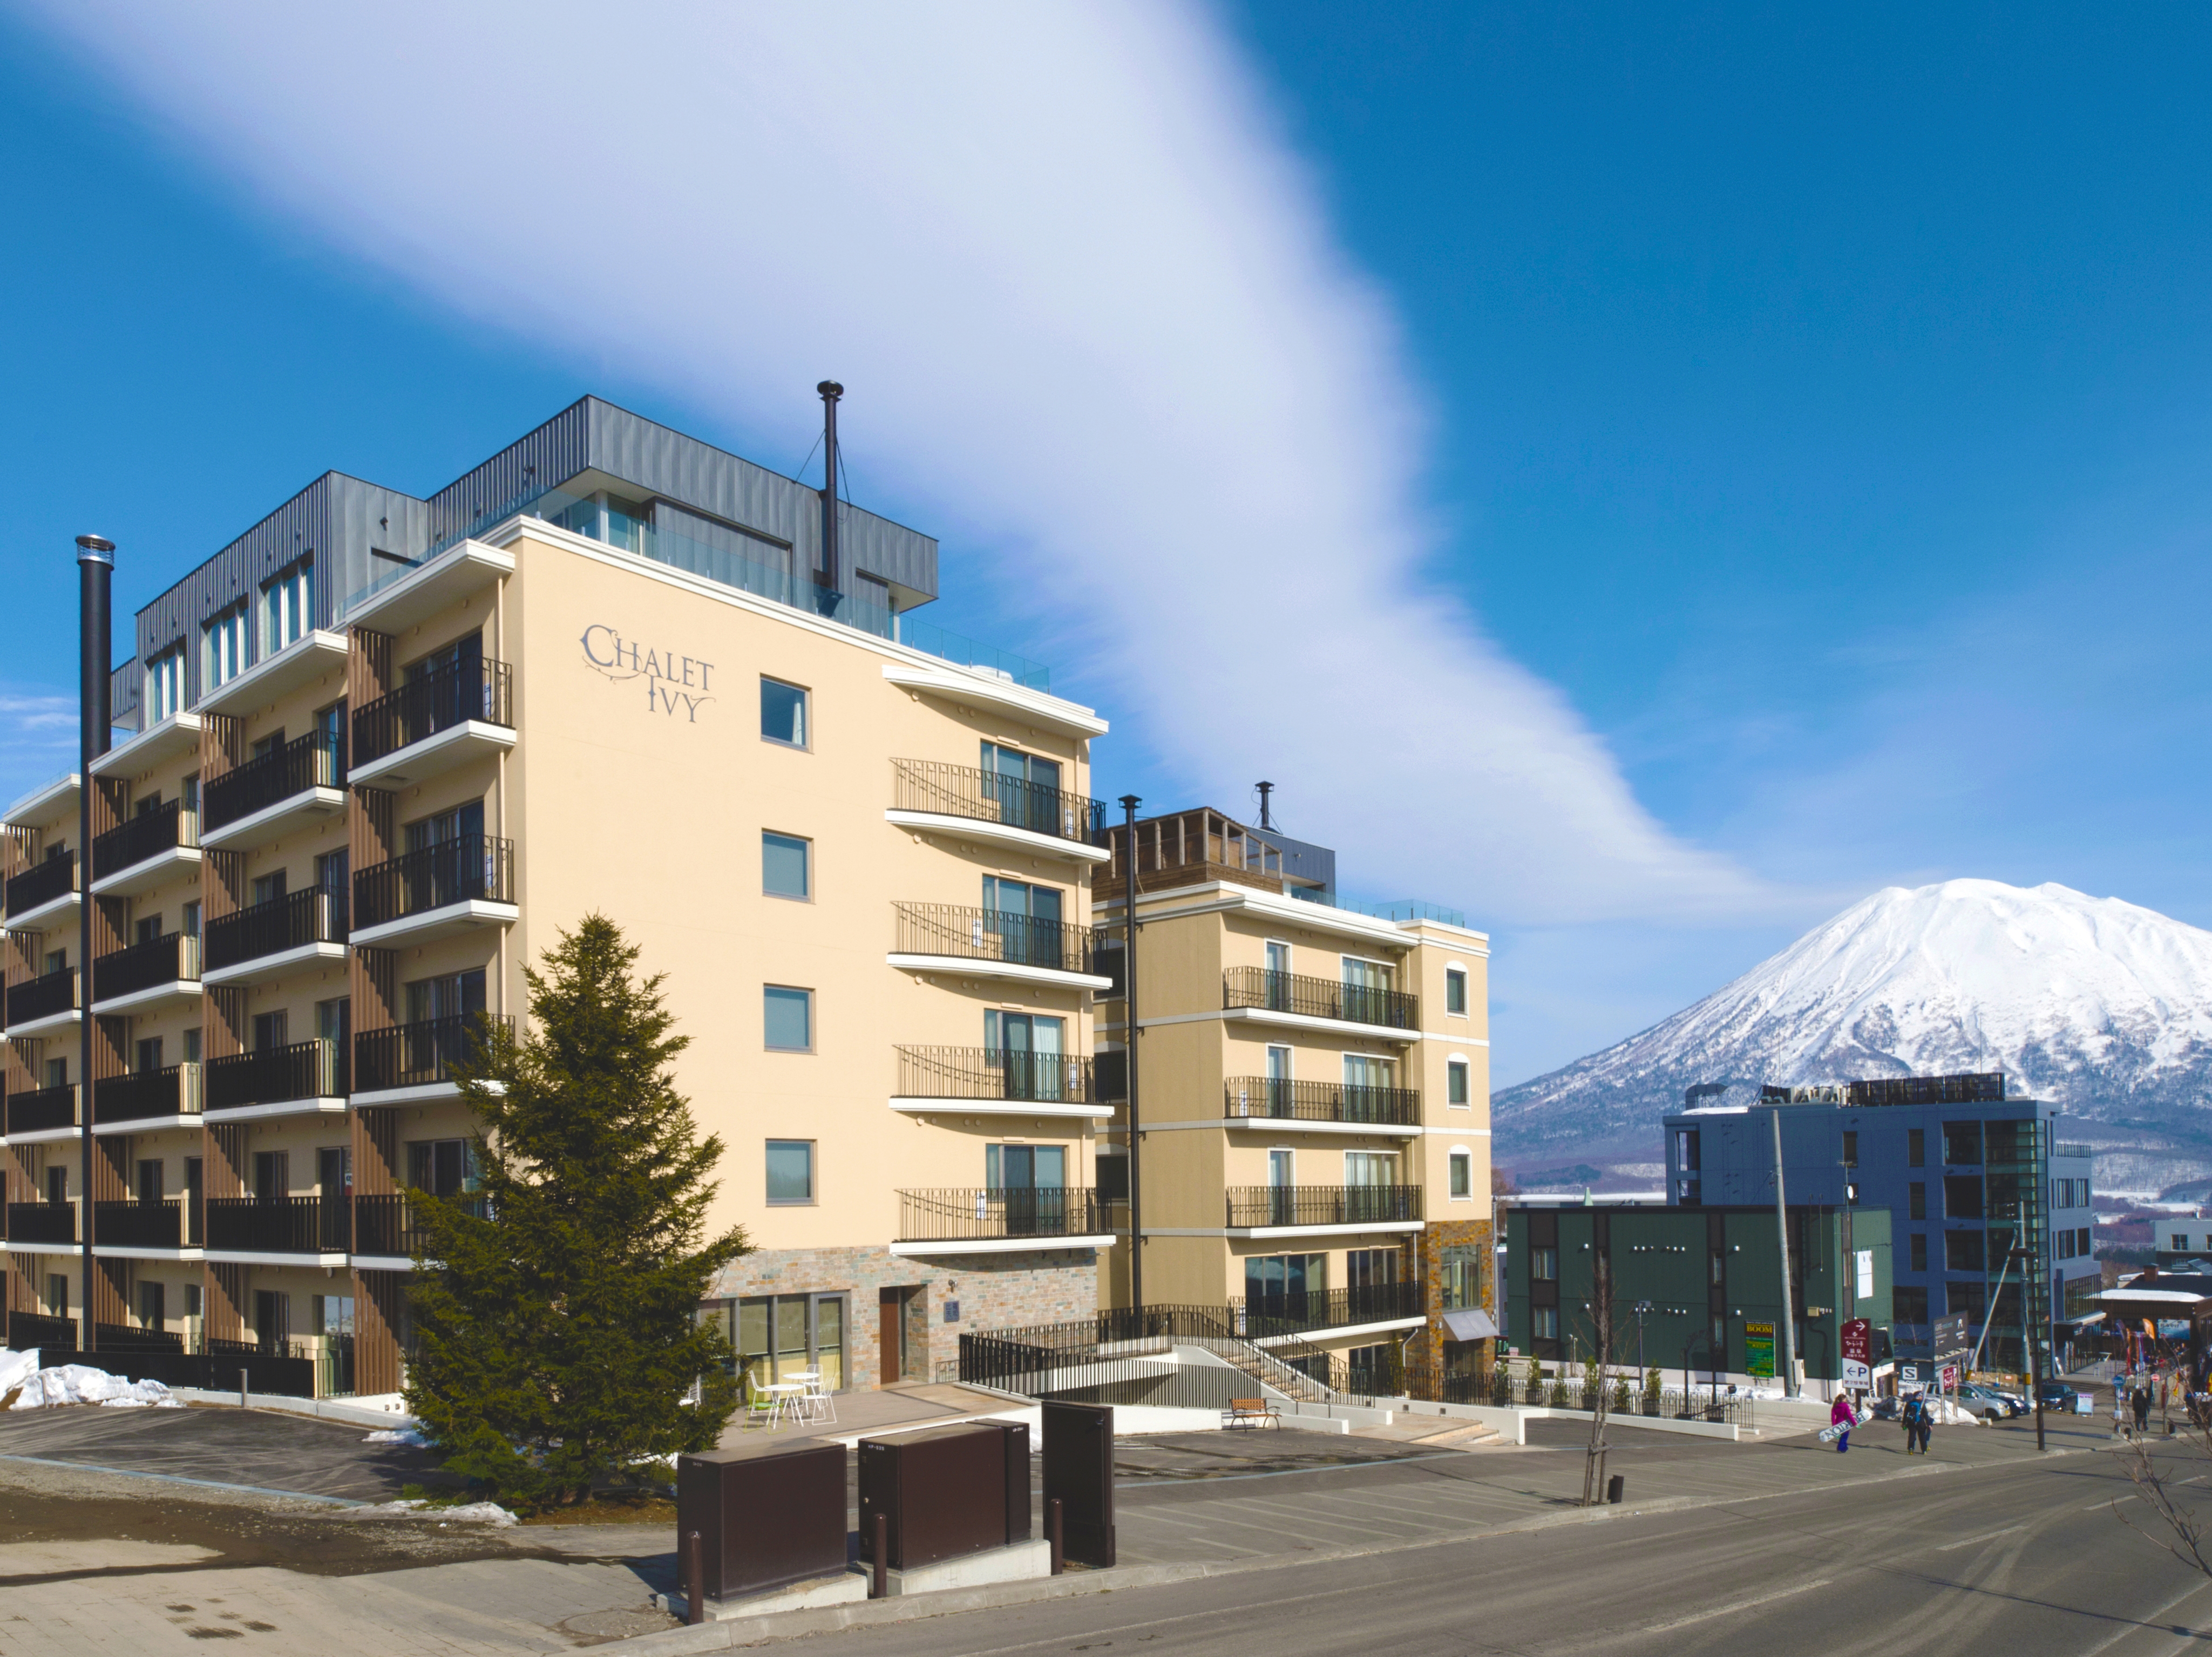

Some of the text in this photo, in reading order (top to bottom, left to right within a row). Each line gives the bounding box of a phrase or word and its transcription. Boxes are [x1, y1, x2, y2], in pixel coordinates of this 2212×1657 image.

[579, 624, 714, 691] CHALET
[647, 675, 716, 724] IVY
[1747, 1325, 1773, 1333] BOOM
[1858, 1367, 1867, 1377] P
[1824, 1412, 1866, 1440] BRTON
